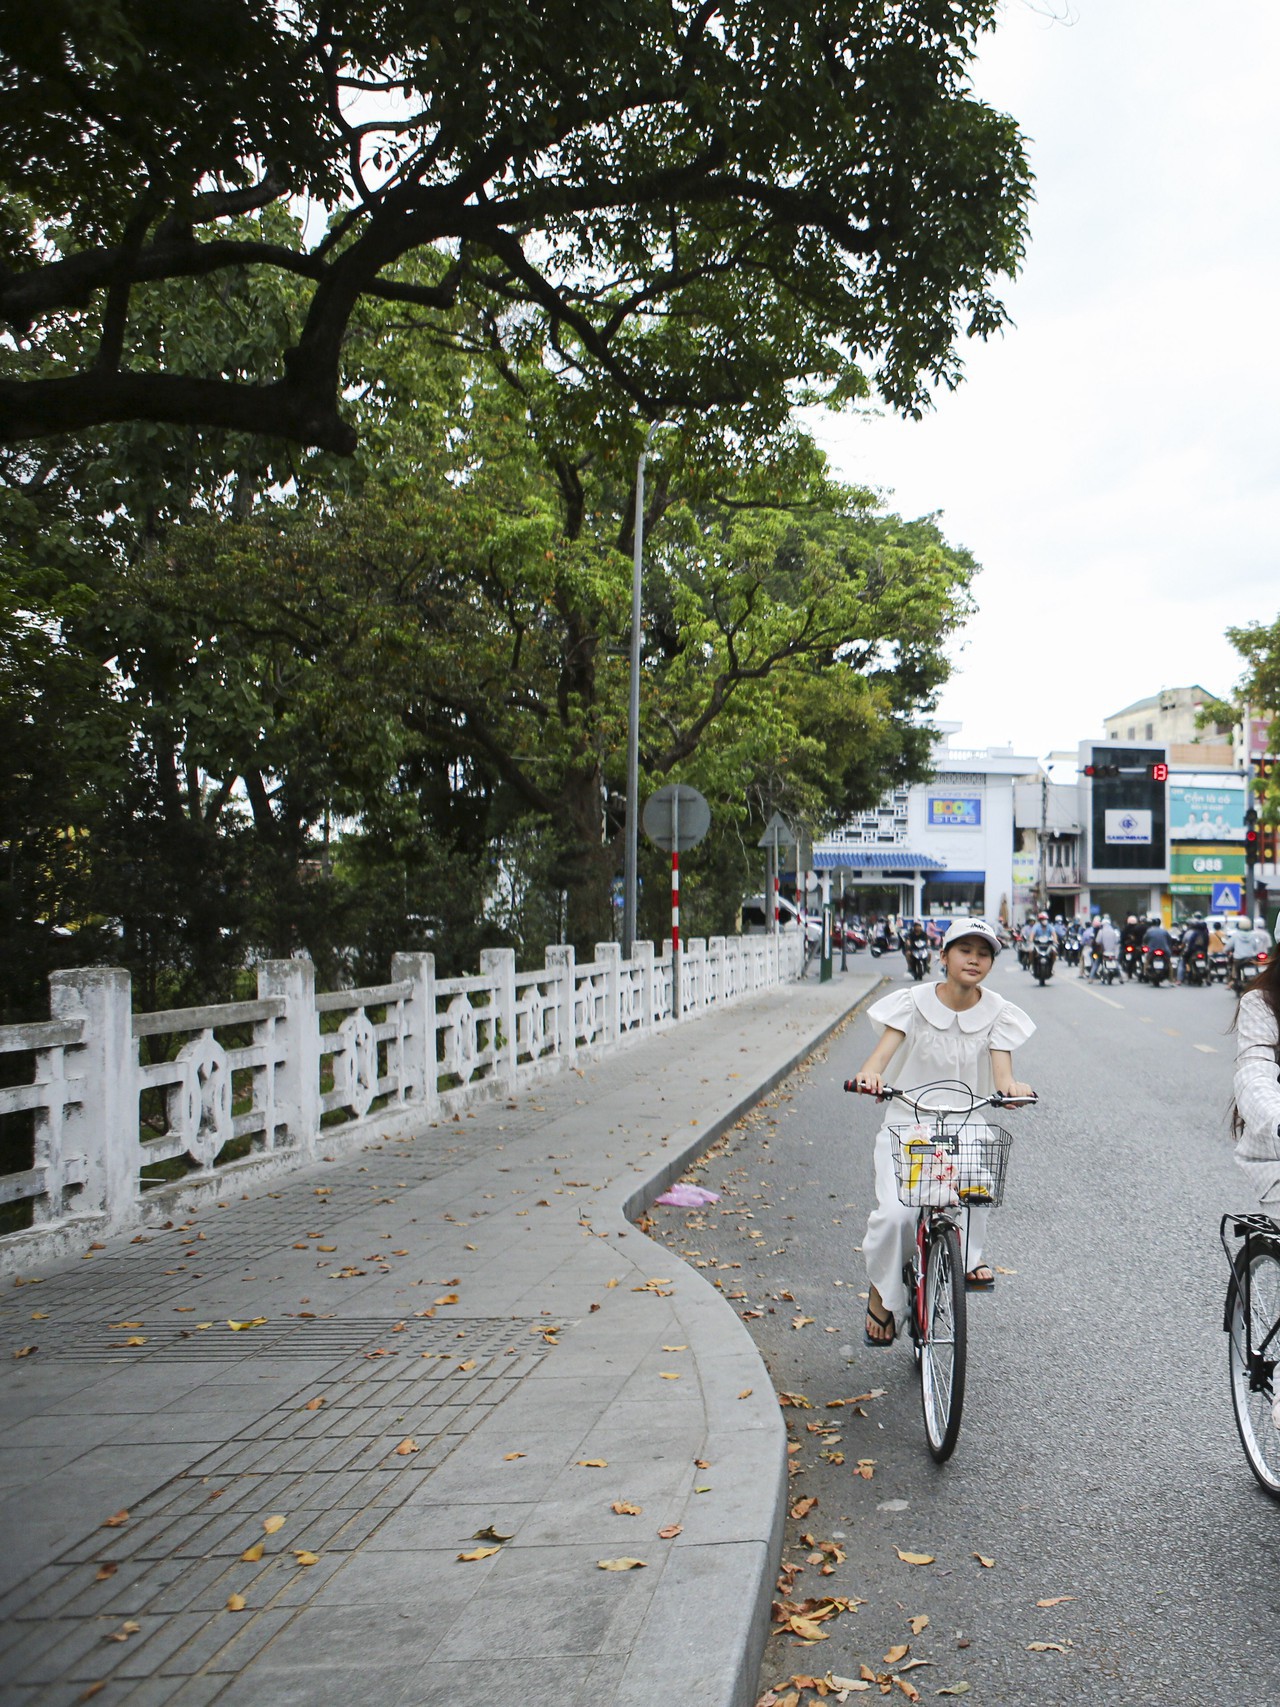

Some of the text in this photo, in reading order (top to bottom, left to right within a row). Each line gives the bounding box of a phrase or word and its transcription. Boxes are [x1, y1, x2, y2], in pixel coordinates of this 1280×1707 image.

[1153, 764, 1167, 781] 13
[933, 800, 976, 815] BOOK
[933, 815, 976, 823] STORE
